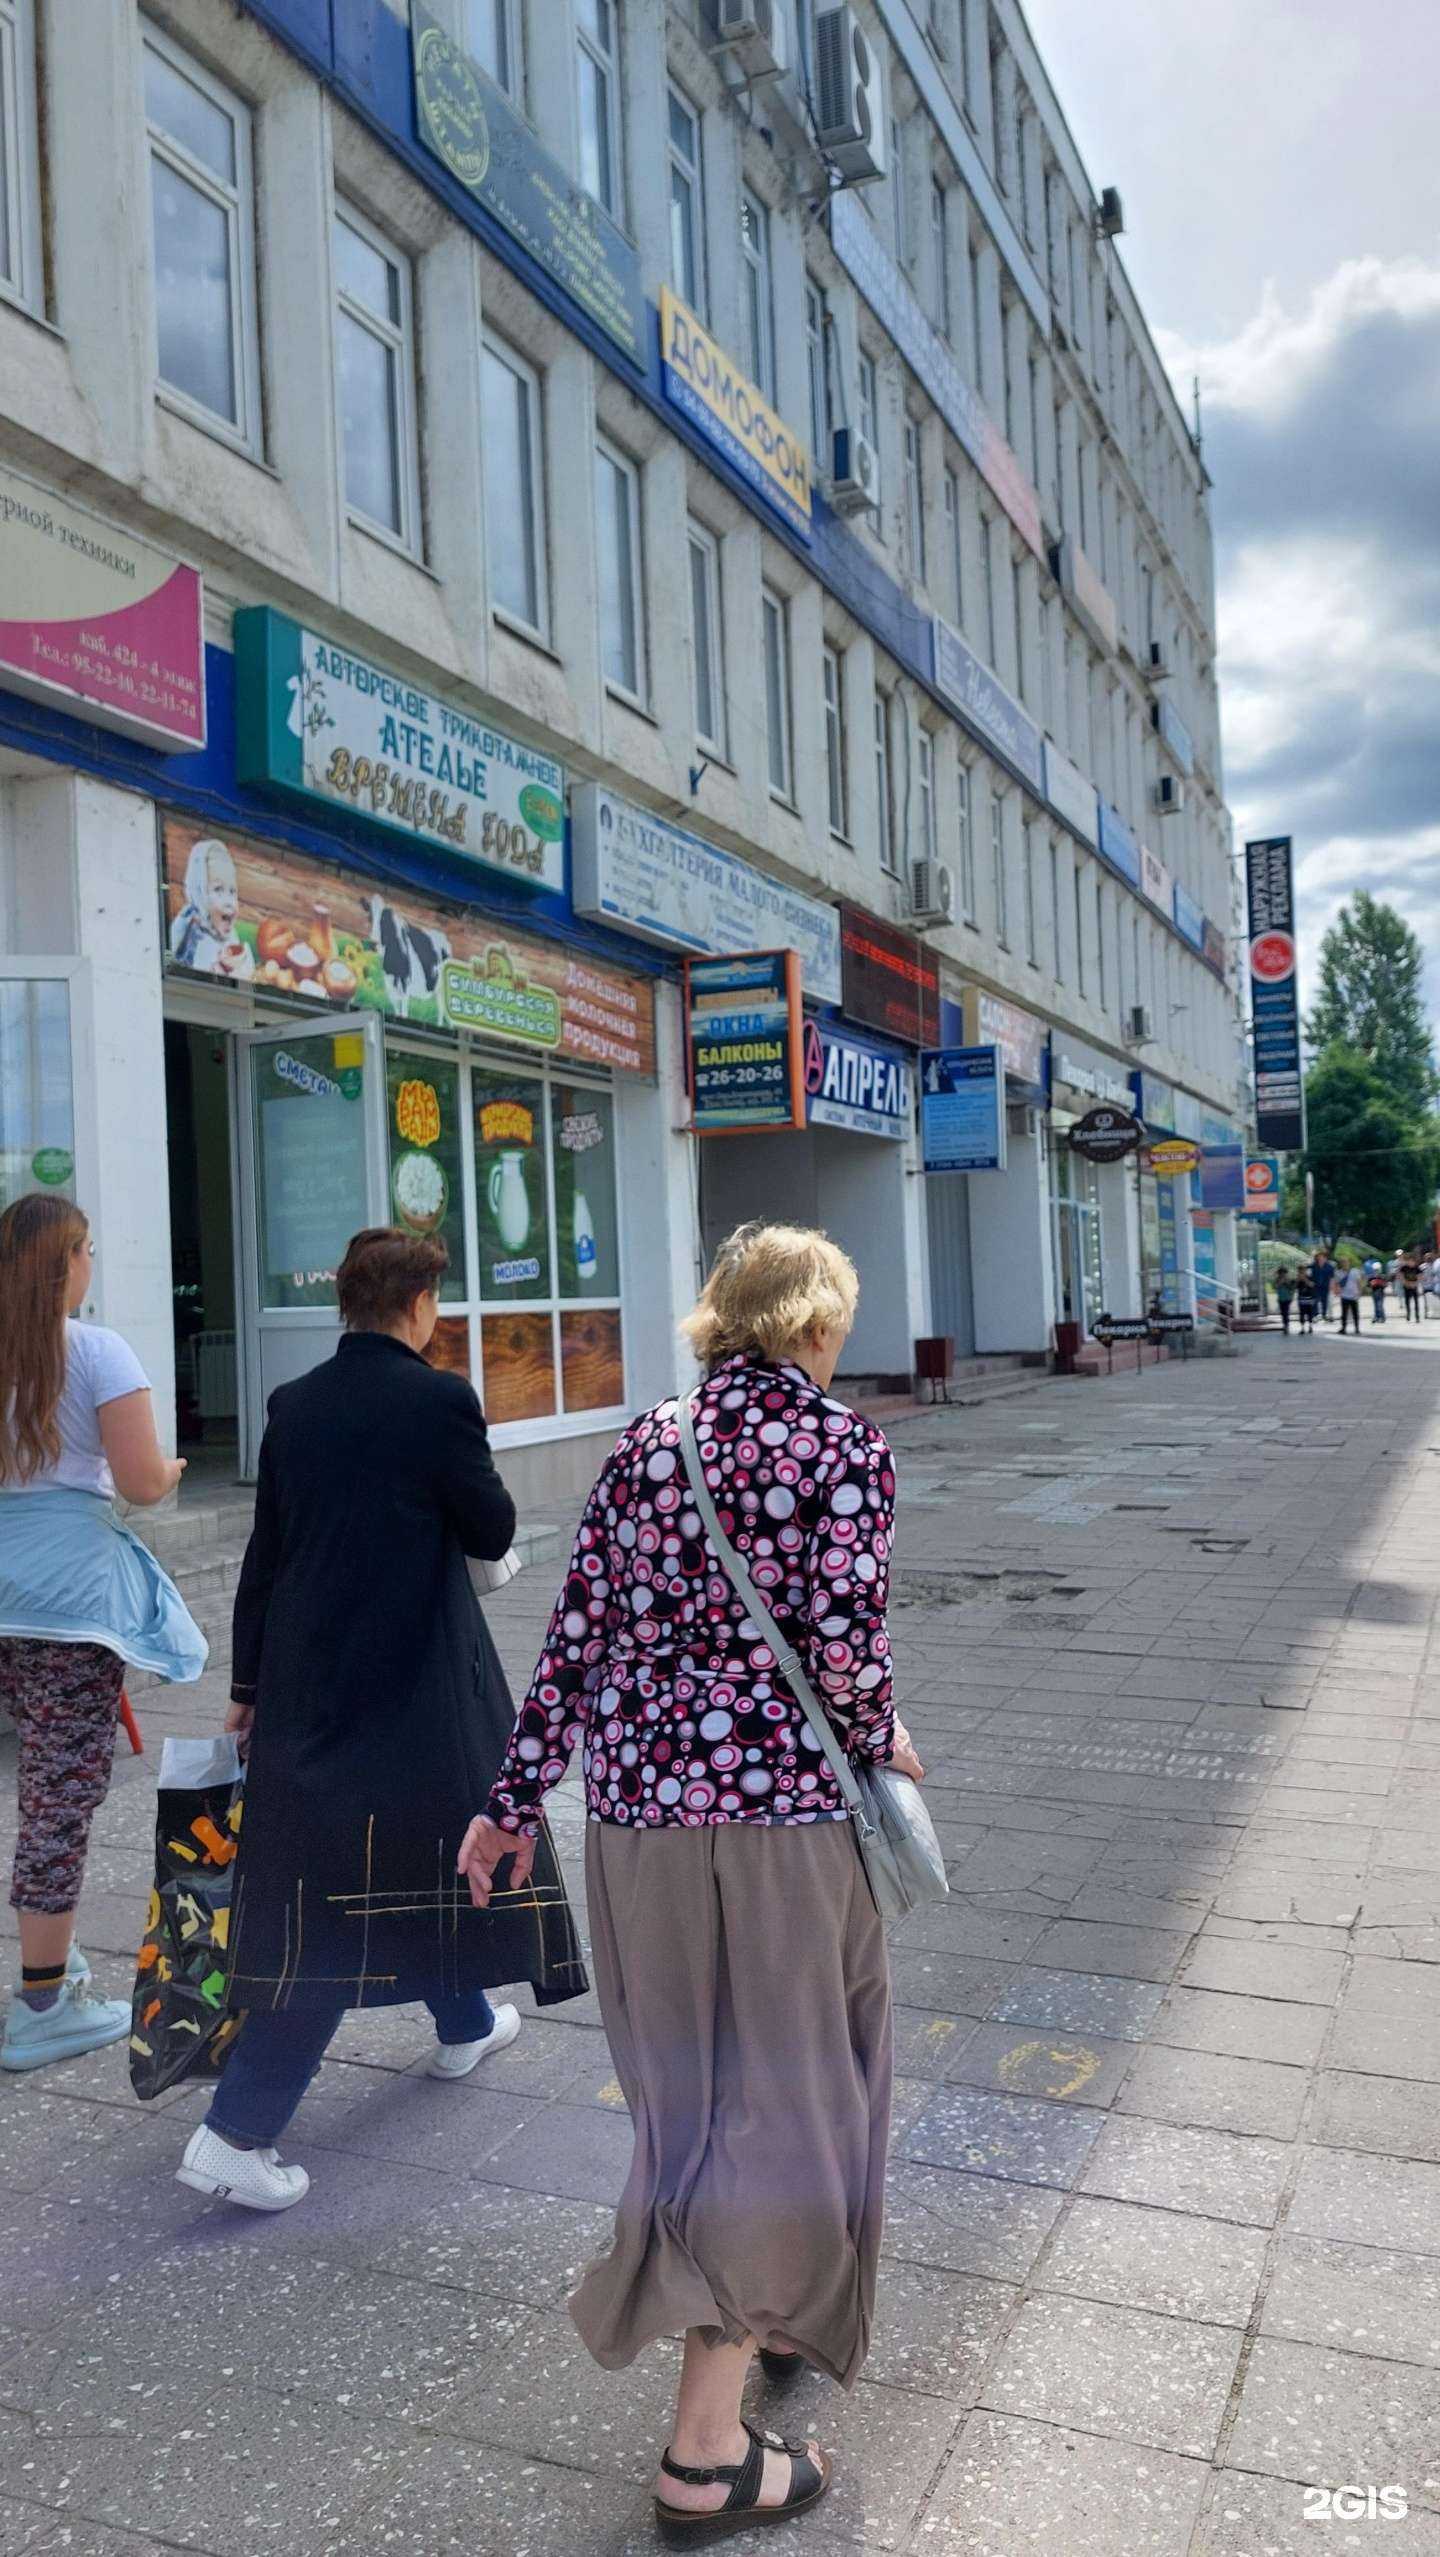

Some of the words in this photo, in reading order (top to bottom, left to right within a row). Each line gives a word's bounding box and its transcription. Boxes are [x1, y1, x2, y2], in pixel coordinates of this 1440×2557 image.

[672, 312, 809, 503] ДОМОФОН
[59, 525, 136, 577] техники
[79, 631, 108, 656] каб.
[112, 641, 138, 667] 424
[150, 662, 160, 677] 4
[315, 645, 429, 724] АВТОРСКОЕ
[440, 709, 560, 790] ТРИКОТАЖНОЕ
[379, 714, 488, 800] АТЕЛЬЕ
[326, 746, 469, 845] ВРЕМЕНА
[481, 811, 546, 876] ГОДА
[1250, 843, 1271, 933] НАРУЖНАЯ
[1270, 845, 1289, 924] РЕКЛАМА
[566, 962, 637, 1014] Домашняя
[709, 1013, 765, 1037] ОКНА
[698, 1041, 783, 1066] БАЛКОНЫ
[709, 1064, 784, 1086] 26-20-26
[823, 1044, 910, 1116] АПРЕЛЬ
[494, 1260, 539, 1282] МОЛОКО
[1094, 1320, 1148, 1337] Пекарня
